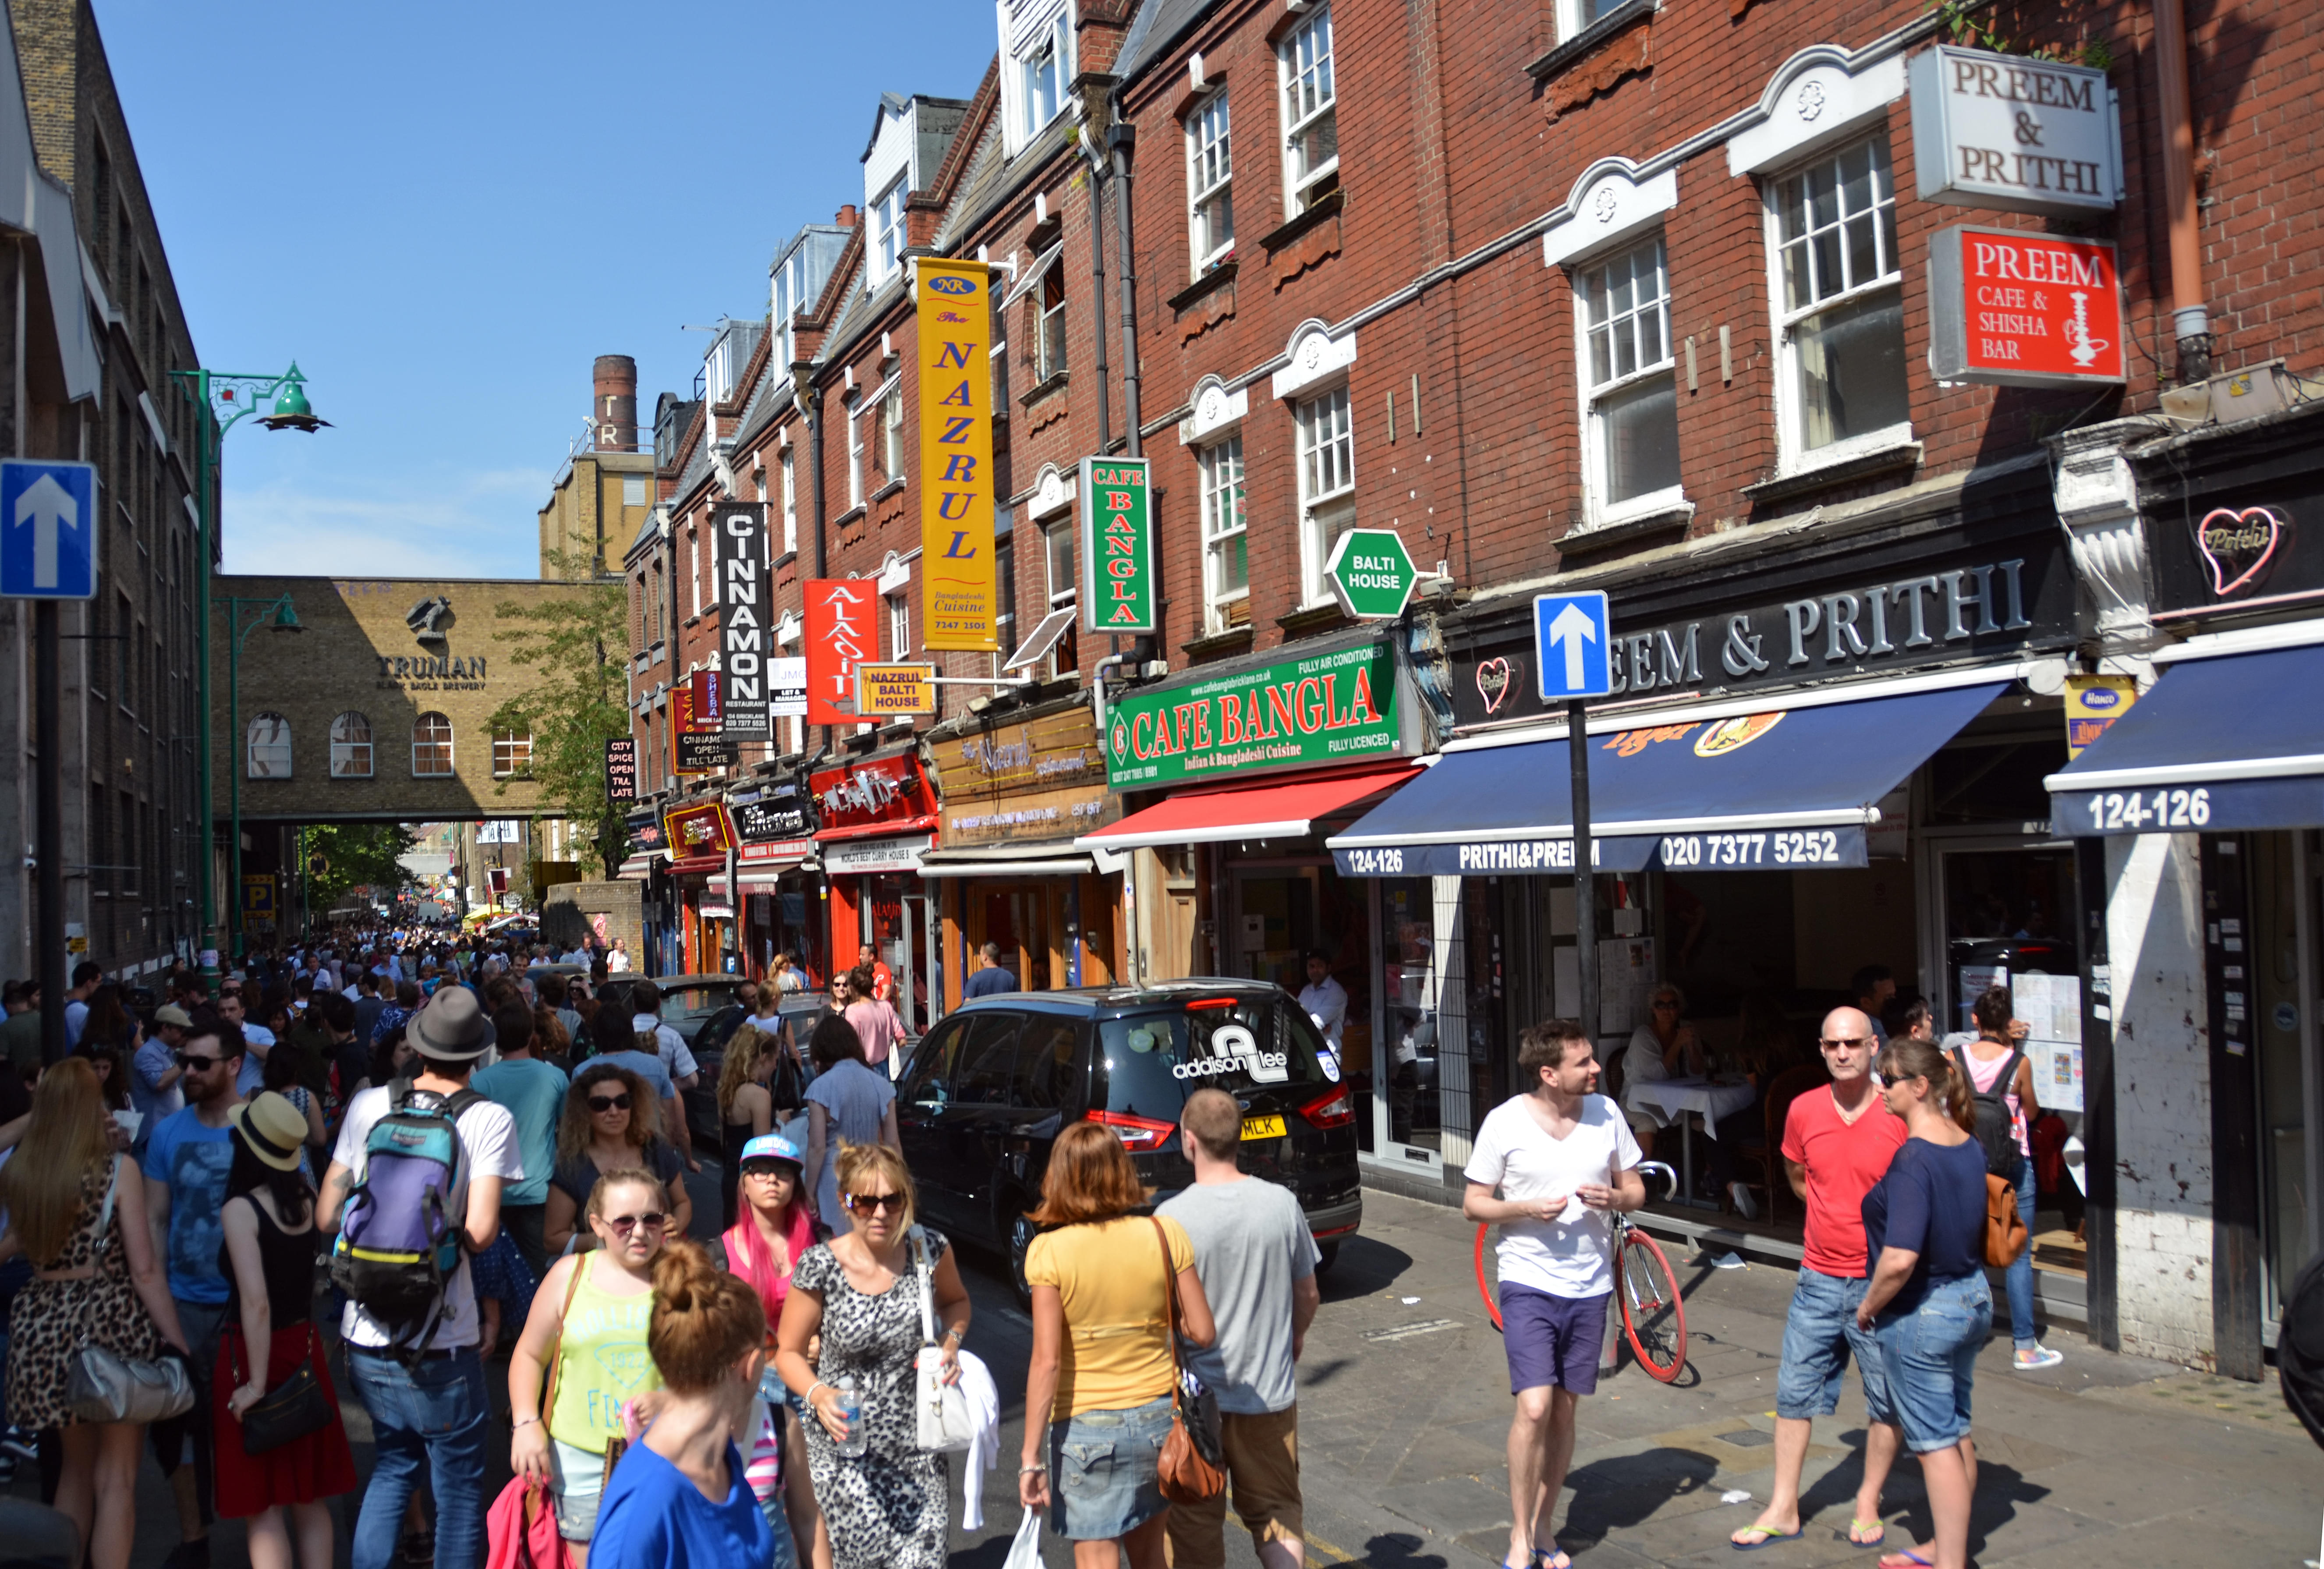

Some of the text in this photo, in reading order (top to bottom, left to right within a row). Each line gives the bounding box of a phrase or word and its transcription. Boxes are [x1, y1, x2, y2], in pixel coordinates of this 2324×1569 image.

[1952, 60, 2096, 113] PREEM
[2014, 112, 2044, 147] &
[1959, 145, 2101, 196] PRITHI
[1974, 242, 2104, 288] PREEM
[938, 279, 967, 293] NR
[1977, 286, 2048, 310] CAFE &
[936, 312, 970, 323] The
[1979, 312, 2048, 336] SHISHA
[1981, 338, 2020, 360] BAR
[932, 341, 978, 559] NAZRUL
[1093, 468, 1144, 486] CAFE
[1105, 491, 1140, 623] BANGLA
[1353, 556, 1395, 570] BALTI
[1349, 573, 1400, 589] HOUSE
[935, 591, 985, 600] Bangladeshi
[726, 514, 761, 700] CINNAMON
[934, 600, 985, 613] Cuisine
[1611, 558, 2032, 694] EEM & PRITHI
[376, 655, 487, 680] TRUMAN
[1298, 646, 1384, 675] FULLY AIR CONDITIONED
[781, 670, 807, 680] JMG
[871, 672, 923, 683] NAZRUL
[410, 681, 438, 691] EAGLE
[443, 681, 486, 691] BREWERY
[708, 674, 718, 717] SHEBA
[879, 685, 916, 694] BALTI
[875, 697, 920, 707] HOUSE
[2086, 692, 2115, 705] Hanco
[1132, 666, 1383, 761] CAFE BANGLA
[611, 741, 631, 751] CITY
[683, 735, 723, 744] CINNAMO
[1328, 733, 1389, 753] FULLY LICENCED
[608, 754, 634, 762] SPICE
[686, 754, 728, 765] TILL LATE
[1184, 741, 1302, 771] Indian & Bangladeshi Cuisine
[609, 765, 634, 774] OPEN
[612, 777, 631, 786] TILL
[611, 788, 633, 797] LATE
[2088, 788, 2211, 830] 124-126
[841, 853, 860, 863] WORLD'S
[860, 852, 871, 862] BEST
[872, 850, 887, 861] CURRY
[888, 850, 905, 861] HOUSE
[1459, 839, 1601, 869] PRITHI&PREM
[1661, 831, 1839, 866] 020 7377 5252
[1347, 849, 1403, 873] 124-126
[1172, 1050, 1288, 1080] addison lee
[570, 1303, 649, 1343] HOLLIS
[610, 1351, 646, 1369] 1922
